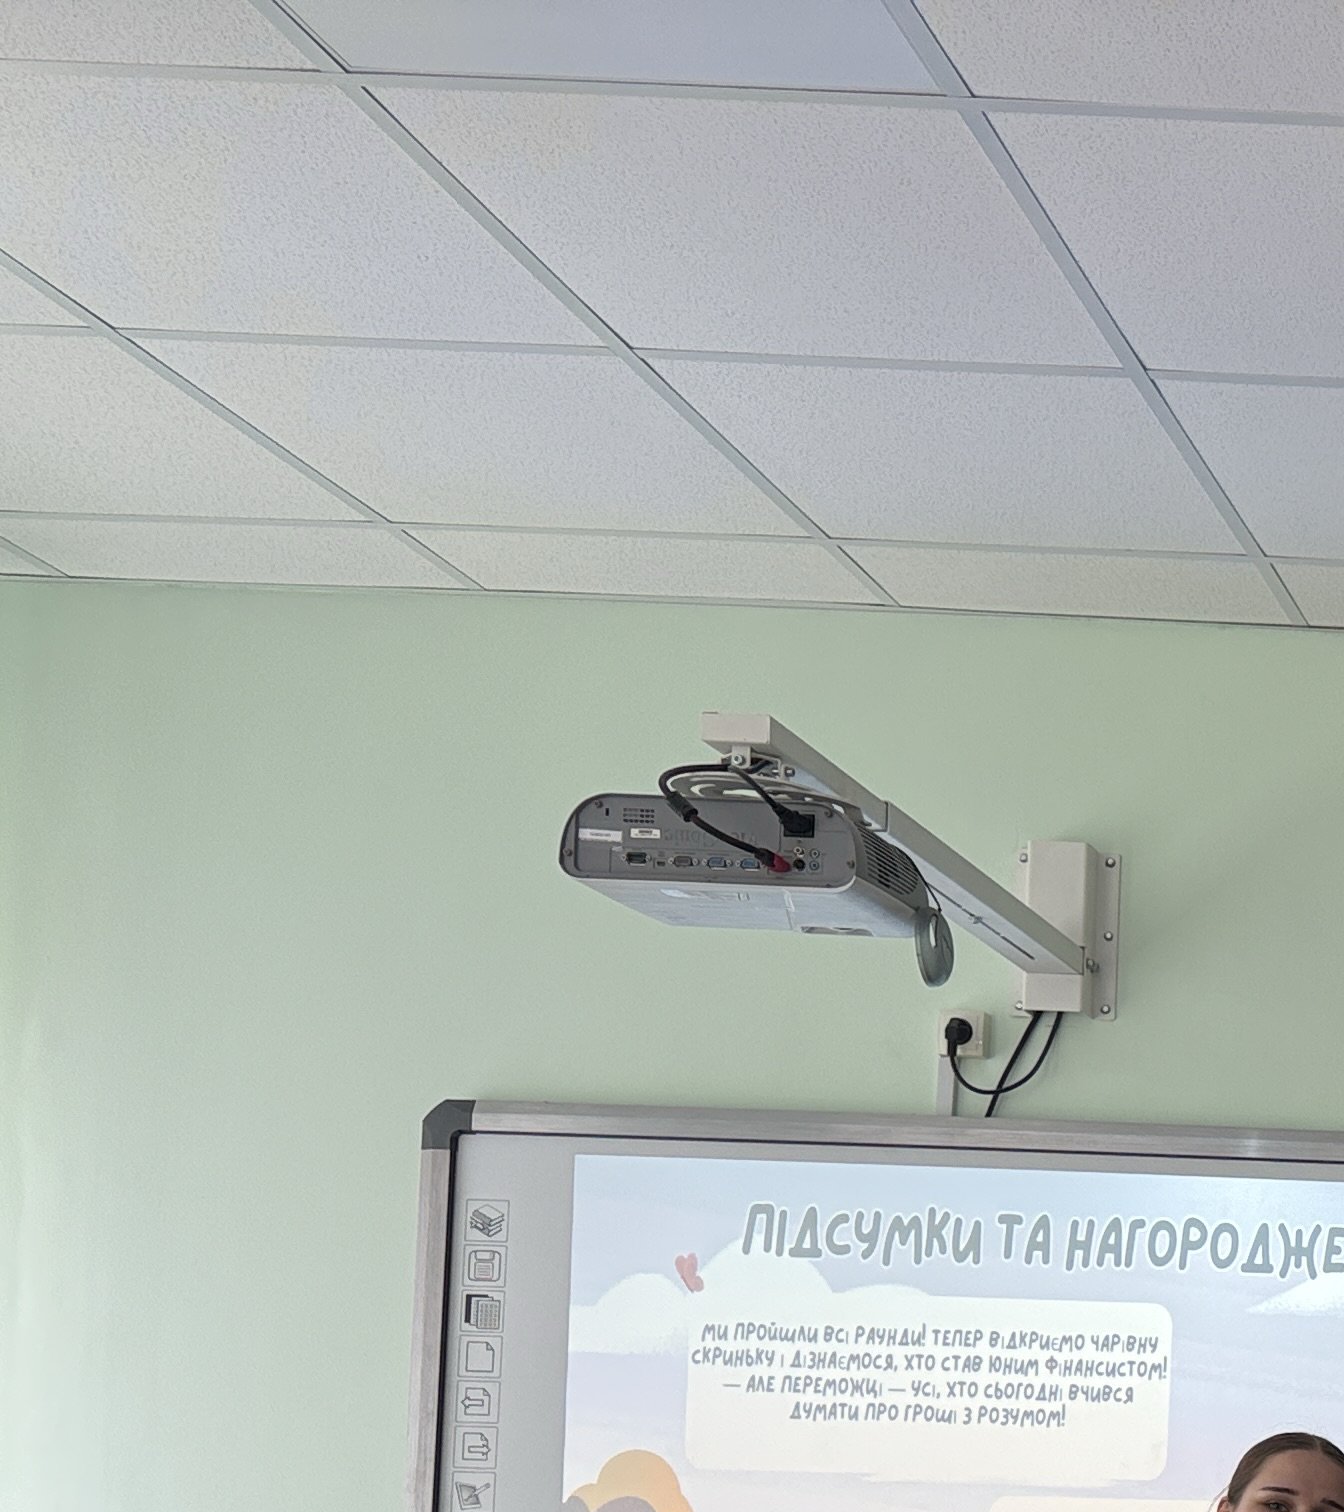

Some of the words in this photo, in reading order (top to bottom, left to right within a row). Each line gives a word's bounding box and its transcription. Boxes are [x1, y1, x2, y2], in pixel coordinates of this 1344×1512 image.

[741, 1202, 982, 1266] ПІДСУМКИ
[999, 1214, 1050, 1266] ТА
[701, 1323, 728, 1342] МИ
[734, 1322, 819, 1344] ПРОЙШЛИ
[824, 1325, 849, 1345] ВСІ
[854, 1323, 926, 1347] РАУНДИ!
[932, 1329, 984, 1349] ТЕПЕР
[989, 1330, 1085, 1353] ВІДКРИЄМО
[1091, 1334, 1159, 1355] ЧАРІВНУ
[691, 1346, 776, 1368] СКРИНЬКУ
[790, 1350, 898, 1372] ДІЗНАЄМОСЯ,
[904, 1353, 936, 1372] ХТО
[941, 1355, 984, 1374] СТАВ
[989, 1355, 1039, 1377] ЮНИМ
[1045, 1355, 1168, 1380] ФІНАНСИСТОМ!
[746, 1374, 775, 1393] АЛЕ
[780, 1374, 883, 1398] ПЕРЕМОЖЦІ
[911, 1379, 941, 1398] УСІ,
[946, 1381, 978, 1399] ХТО
[984, 1382, 1063, 1403] СЬОГОДНІ
[1068, 1383, 1134, 1405] ВЧИВСЯ
[789, 1401, 859, 1423] ДУМАТИ
[864, 1402, 899, 1423] ПРО
[903, 1404, 957, 1425] ГРОШІ
[977, 1404, 1066, 1428] РОЗУМОМ!
